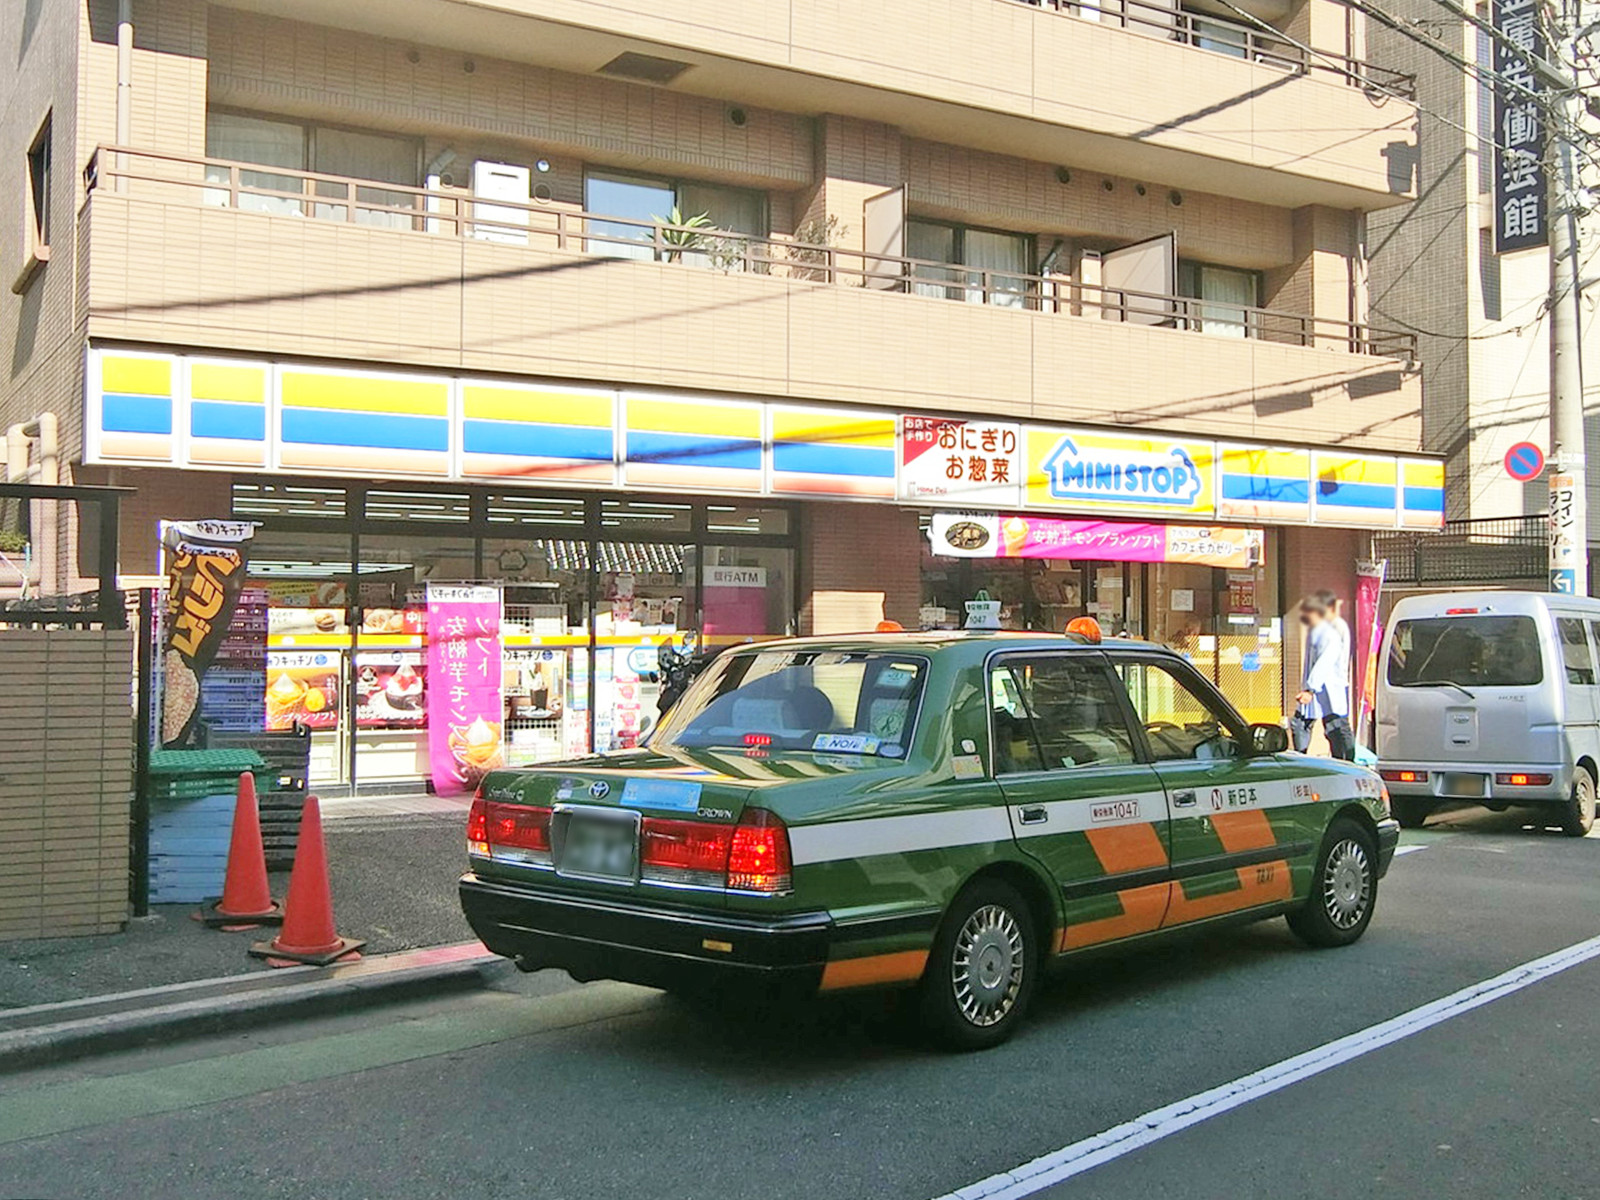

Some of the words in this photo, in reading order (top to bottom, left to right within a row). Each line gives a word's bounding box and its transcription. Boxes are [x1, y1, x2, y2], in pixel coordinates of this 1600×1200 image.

[904, 418, 934, 430] お店で
[904, 430, 934, 442] 手作り
[938, 424, 1016, 455] おにぎり
[945, 454, 1010, 484] お惣菜
[1062, 458, 1187, 494] MINISTOP
[1559, 490, 1574, 528] コイン
[1032, 528, 1162, 549] 安納芋モンブランソフト
[1170, 540, 1243, 556] カフェモカゼリー
[713, 570, 759, 583] 銀行ATM
[1227, 787, 1258, 807] 新日本
[696, 806, 733, 819] CROWN
[1113, 801, 1139, 819] 1047
